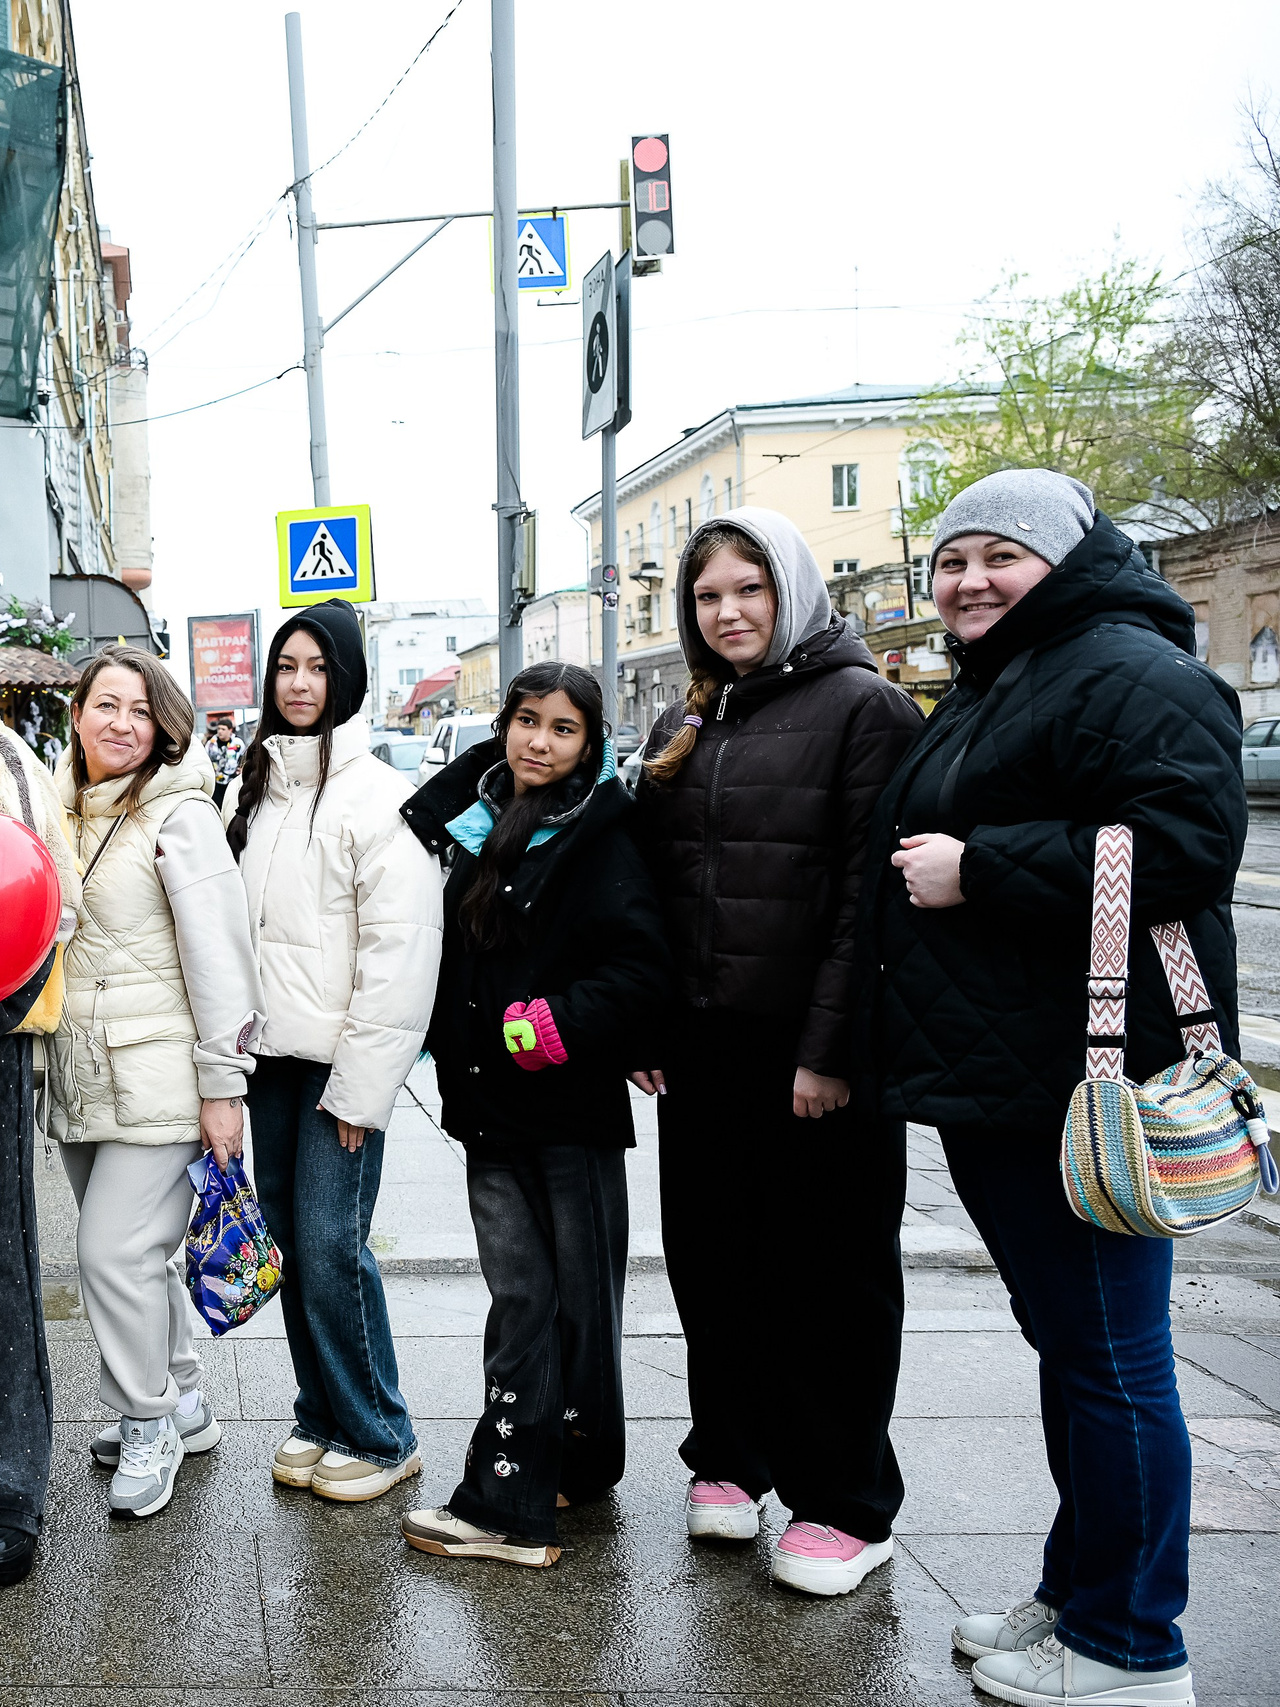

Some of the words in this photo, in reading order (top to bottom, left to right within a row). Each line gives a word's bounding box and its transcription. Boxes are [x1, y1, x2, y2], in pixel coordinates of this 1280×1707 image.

[195, 635, 248, 648] ЗАВТРАК
[209, 665, 236, 674] КОФЕ
[204, 674, 250, 684] ПОДАРОК
